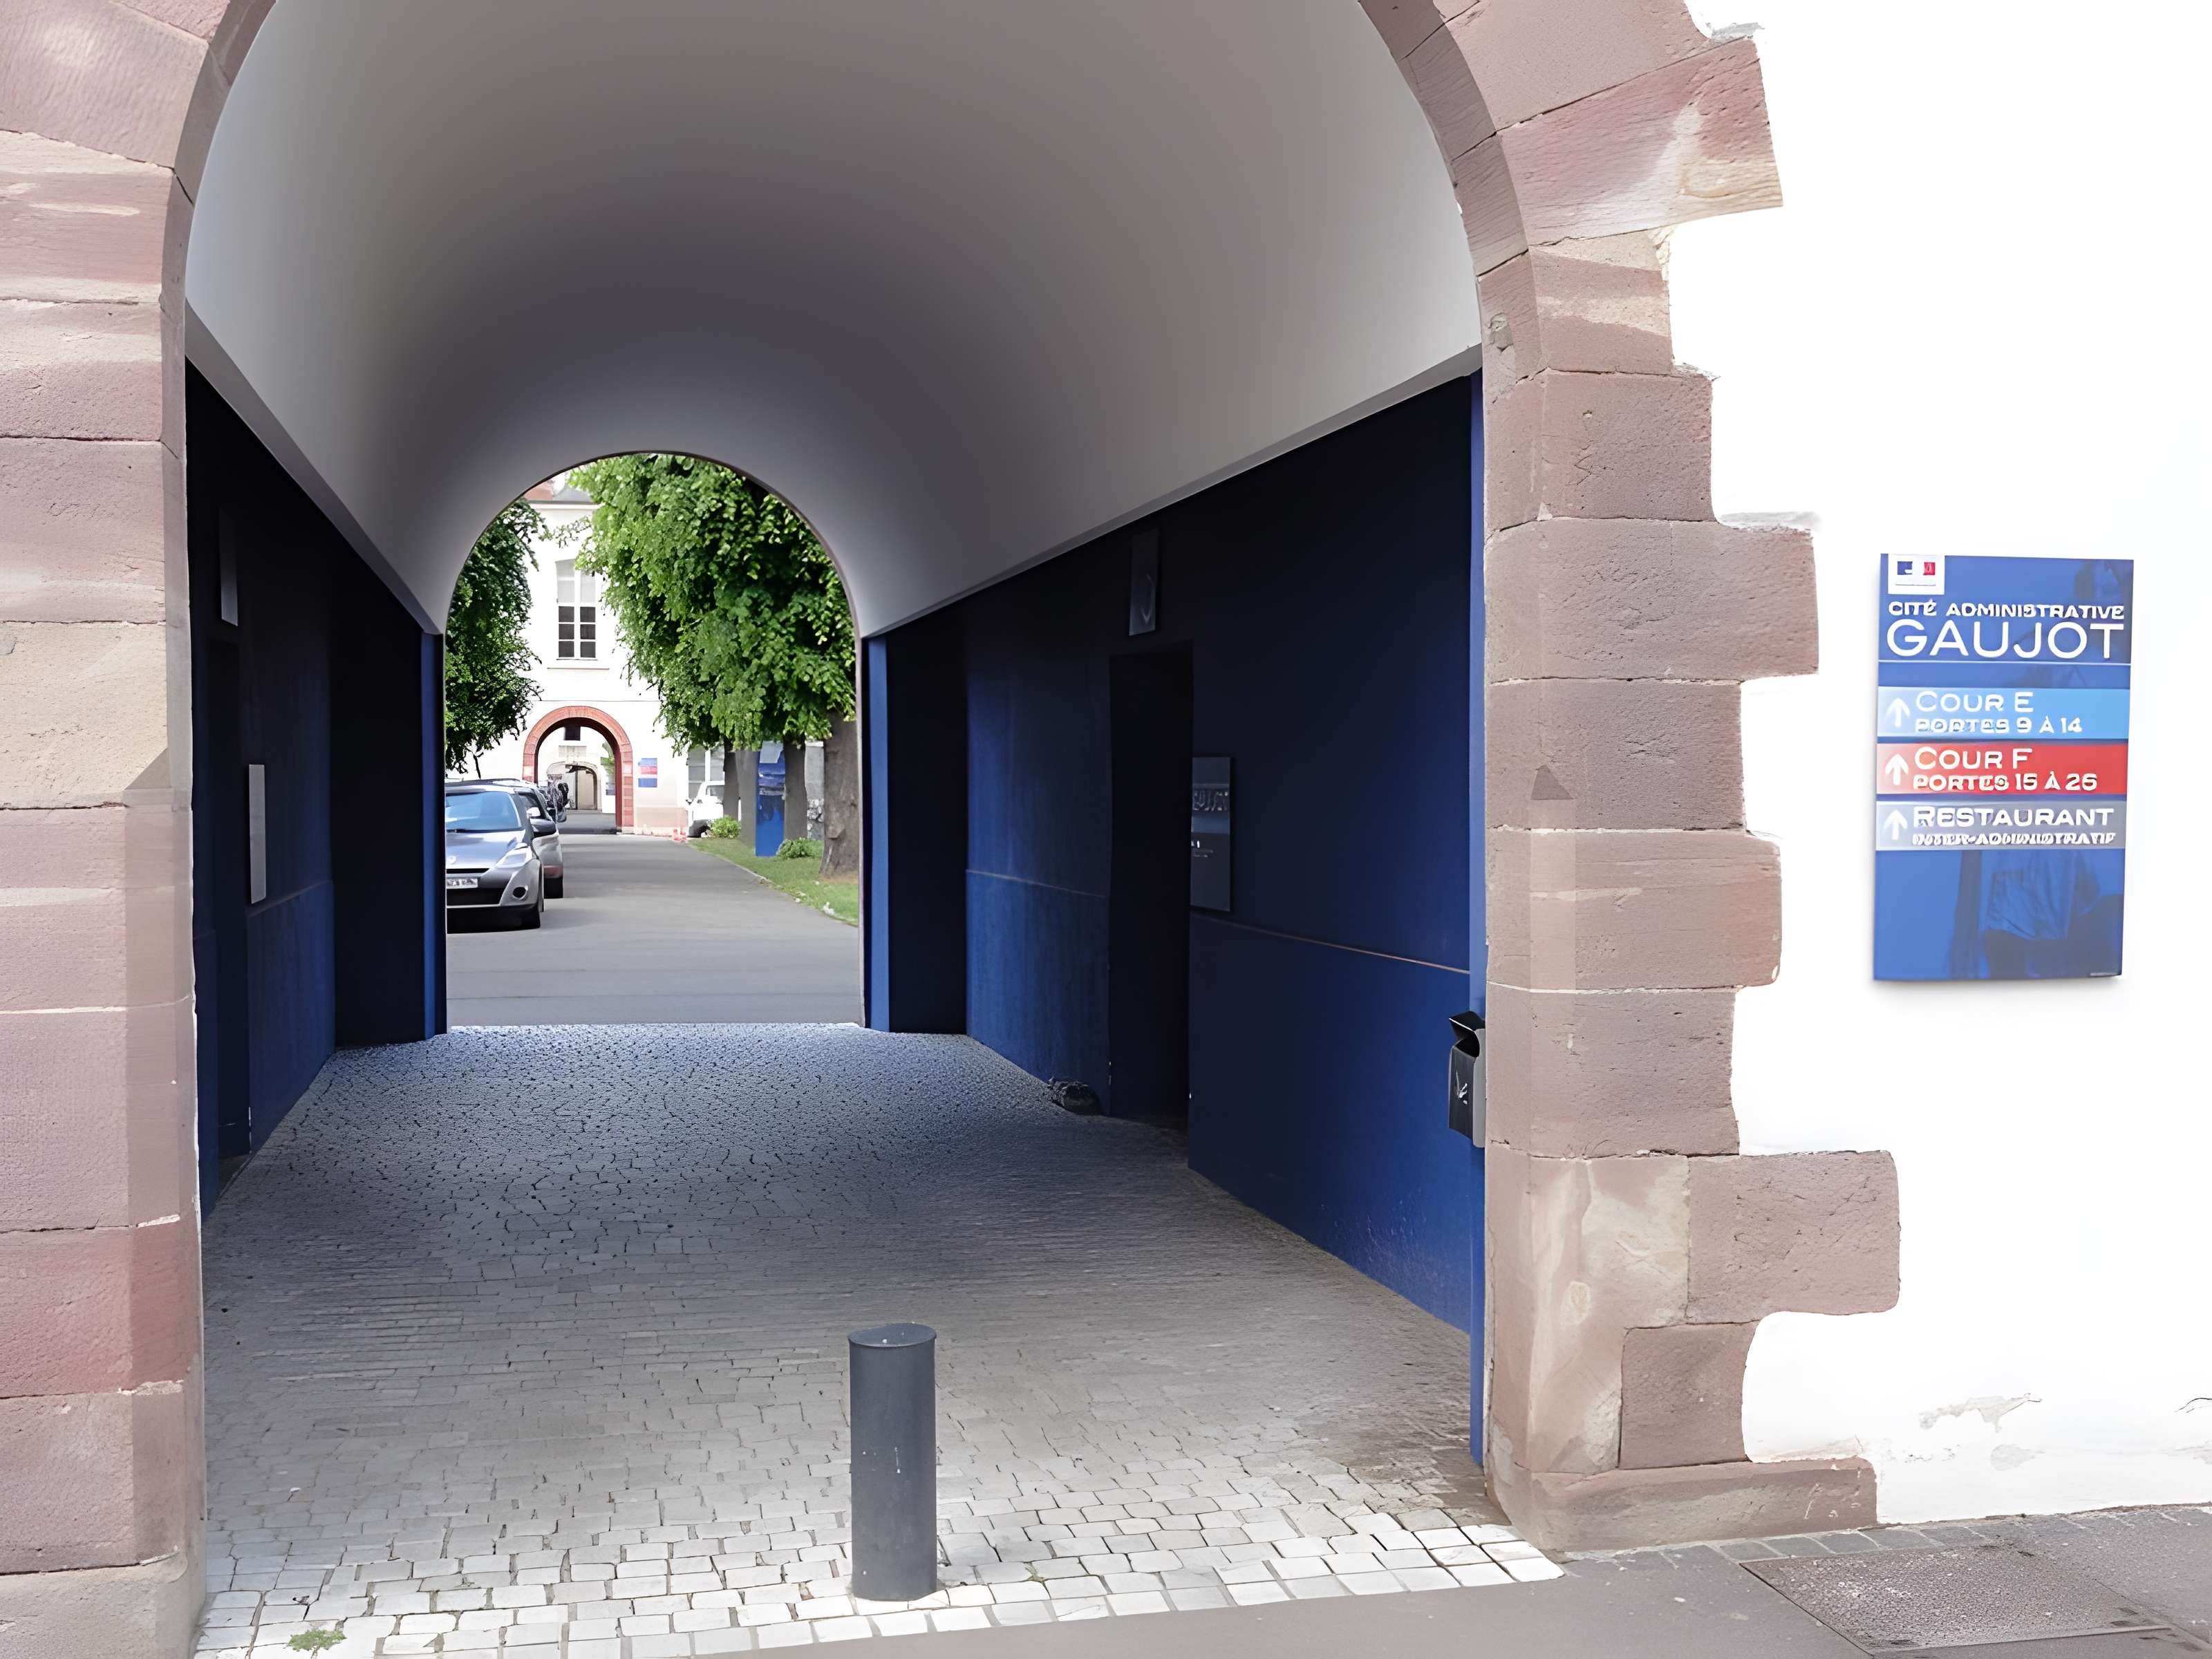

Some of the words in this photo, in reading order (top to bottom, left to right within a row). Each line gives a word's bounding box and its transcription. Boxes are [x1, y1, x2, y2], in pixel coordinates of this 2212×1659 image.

[1888, 599, 1937, 617] CITÉ
[1946, 603, 2124, 620] ADMINISTRATIVE
[1886, 619, 2124, 659] GAUJOT
[1915, 691, 2004, 712] COUR
[2014, 691, 2034, 713] E
[1915, 718, 2009, 733] PORTES
[2016, 717, 2032, 733] 9
[2039, 715, 2054, 733] À
[2061, 717, 2083, 733] 14
[1914, 747, 2003, 769] COUR
[2012, 748, 2032, 769] F
[1913, 774, 2009, 791] PORTES
[2016, 773, 2038, 791] 15
[2044, 771, 2061, 790] À
[1913, 805, 2115, 827] RESTAURANT
